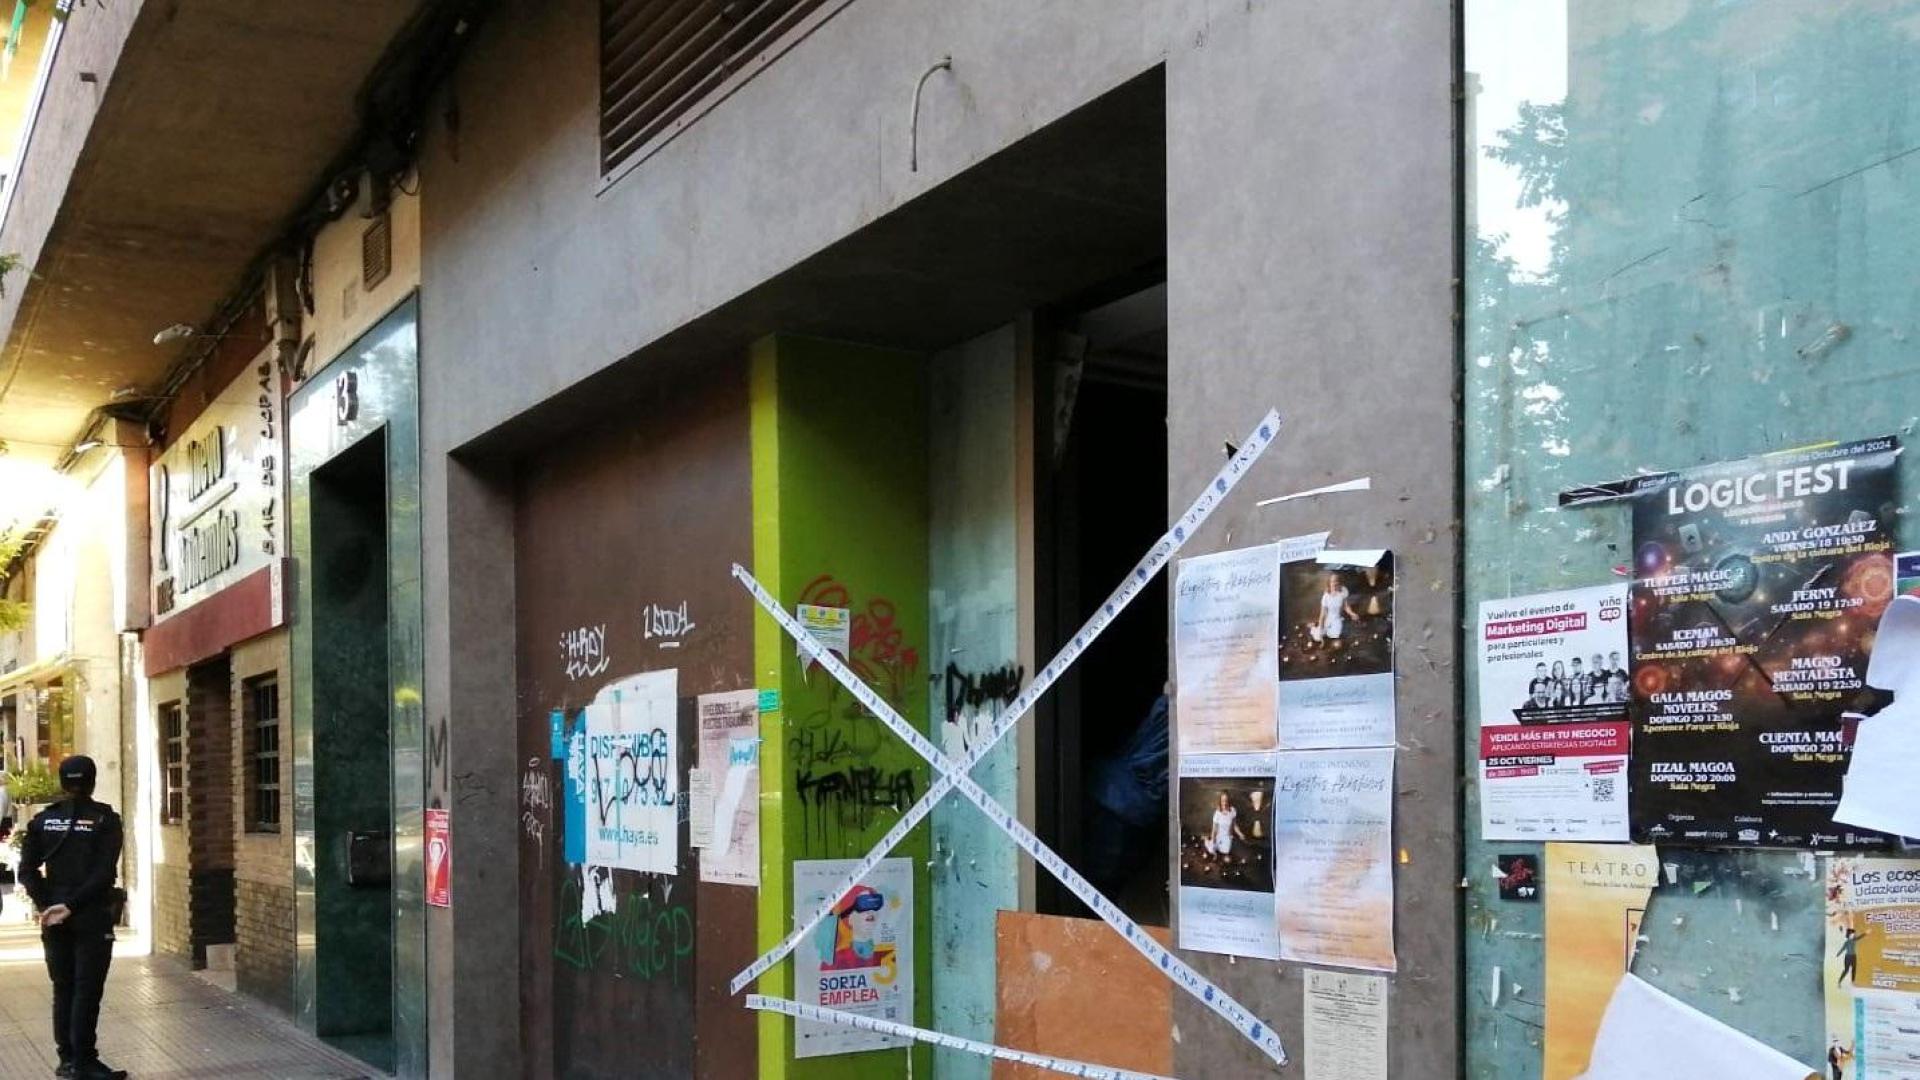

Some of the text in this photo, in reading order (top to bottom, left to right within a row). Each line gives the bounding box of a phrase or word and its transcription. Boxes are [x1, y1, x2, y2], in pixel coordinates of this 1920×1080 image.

[1866, 440, 1892, 452] 2024
[1668, 460, 1855, 515] LOGIC FEST
[262, 497, 275, 556] BAR
[1762, 530, 1800, 544] ANDY
[1691, 570, 1732, 584] MAGIC
[1792, 587, 1838, 601] FERNY
[1487, 602, 1576, 620] Vuelve el evento de
[1818, 600, 1831, 609] 19
[1600, 609, 1620, 619] SEO
[1486, 615, 1585, 637] Marketing Digital
[1673, 627, 1718, 640] ICEMAN
[1487, 640, 1506, 651] para
[1508, 637, 1558, 649] particulares
[1487, 650, 1544, 664] profesionales
[1791, 656, 1842, 669] MAGNO
[1773, 667, 1856, 682] MENTALISTA
[1818, 681, 1830, 690] 19
[1650, 690, 1733, 703] GALA MAGOS
[1663, 702, 1718, 714] NOVELES
[1649, 714, 1691, 724] DOMINGO
[1489, 727, 1617, 743] VENDE MÁS EN TU NEGOCIO
[1759, 732, 1811, 744] CUENTA
[1770, 744, 1818, 753] DOMINGO
[1821, 743, 1834, 753] 20
[1651, 762, 1735, 773] ITZAL MAGOA
[1650, 774, 1693, 782] DOMINGO
[1695, 774, 1707, 782] 20
[1565, 861, 1647, 877] TEATRO
[1853, 871, 1880, 885] Los
[819, 974, 868, 992] SORIA
[820, 988, 880, 1007] EMPLEA
